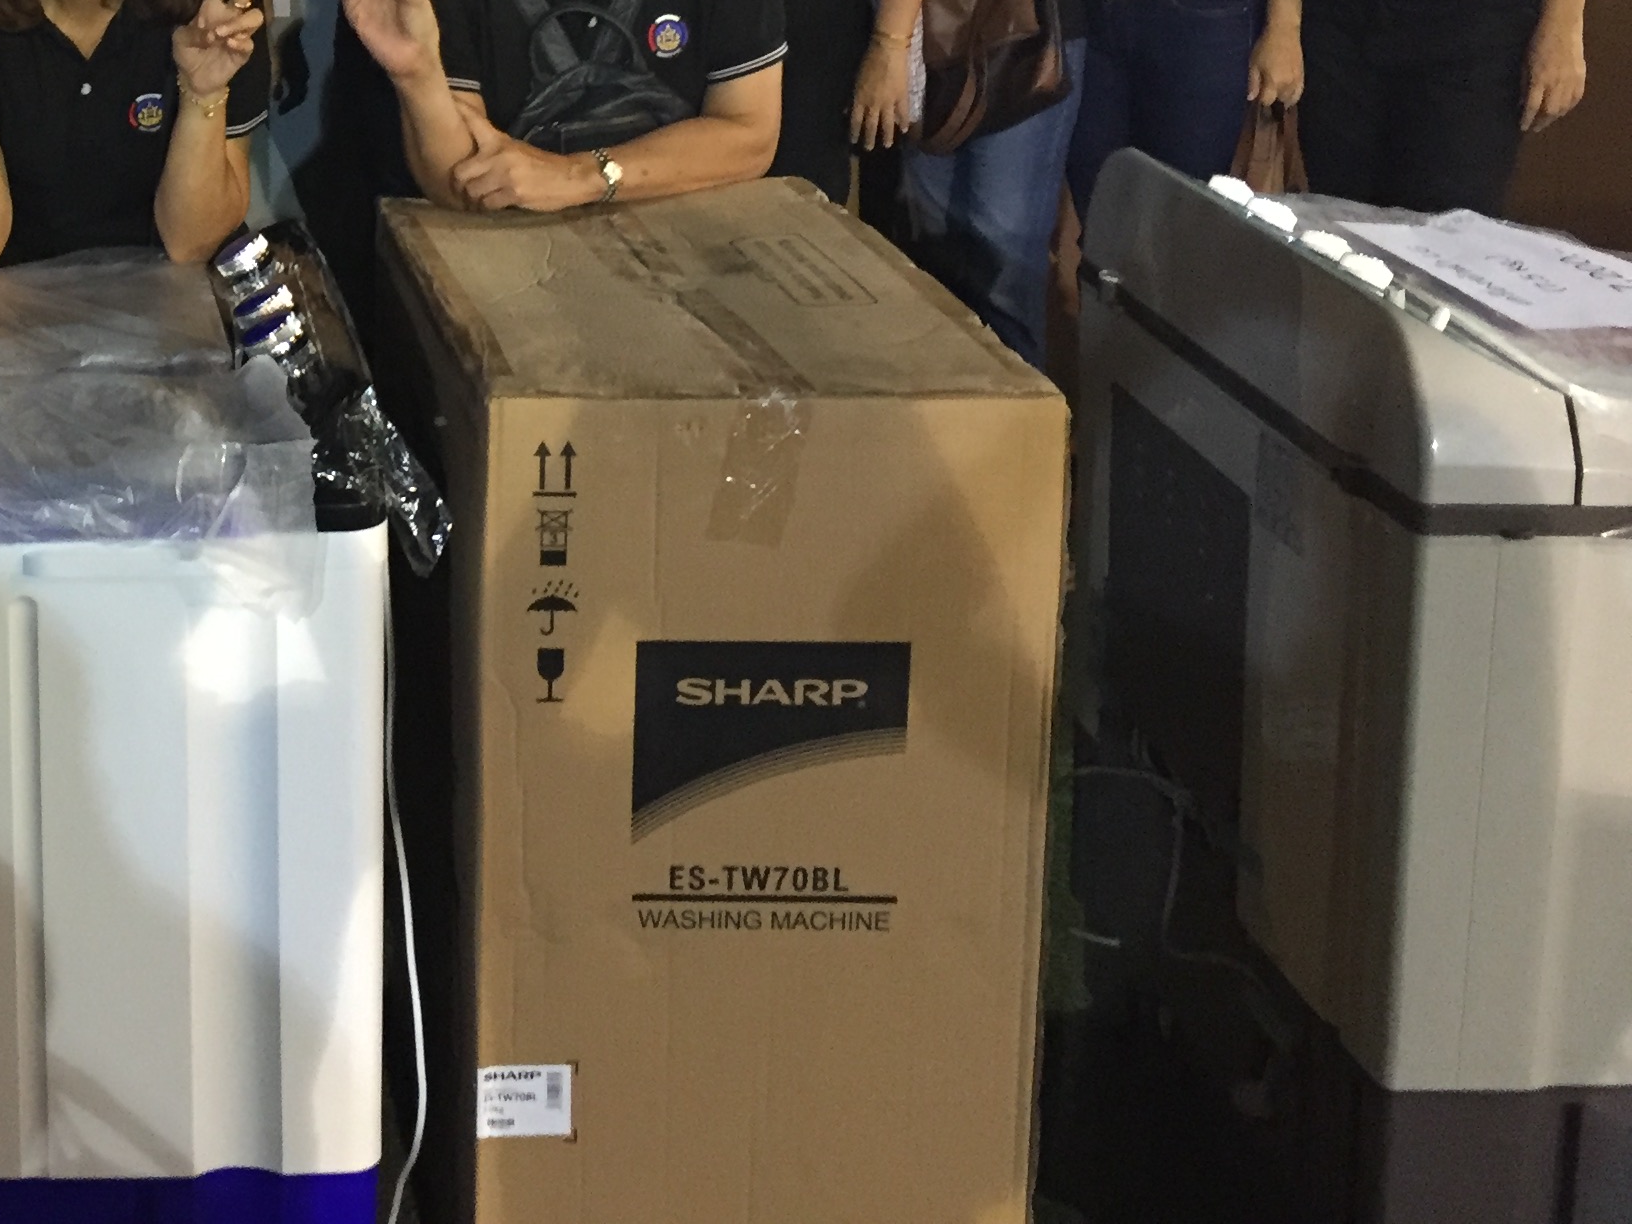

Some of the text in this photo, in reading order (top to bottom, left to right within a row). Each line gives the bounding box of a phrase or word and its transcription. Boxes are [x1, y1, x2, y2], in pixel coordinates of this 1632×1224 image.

[675, 677, 868, 707] SHARP
[668, 864, 850, 892] ES-TW70BL
[638, 908, 891, 933] WASHING MACHINE
[484, 1070, 542, 1082] SHARP
